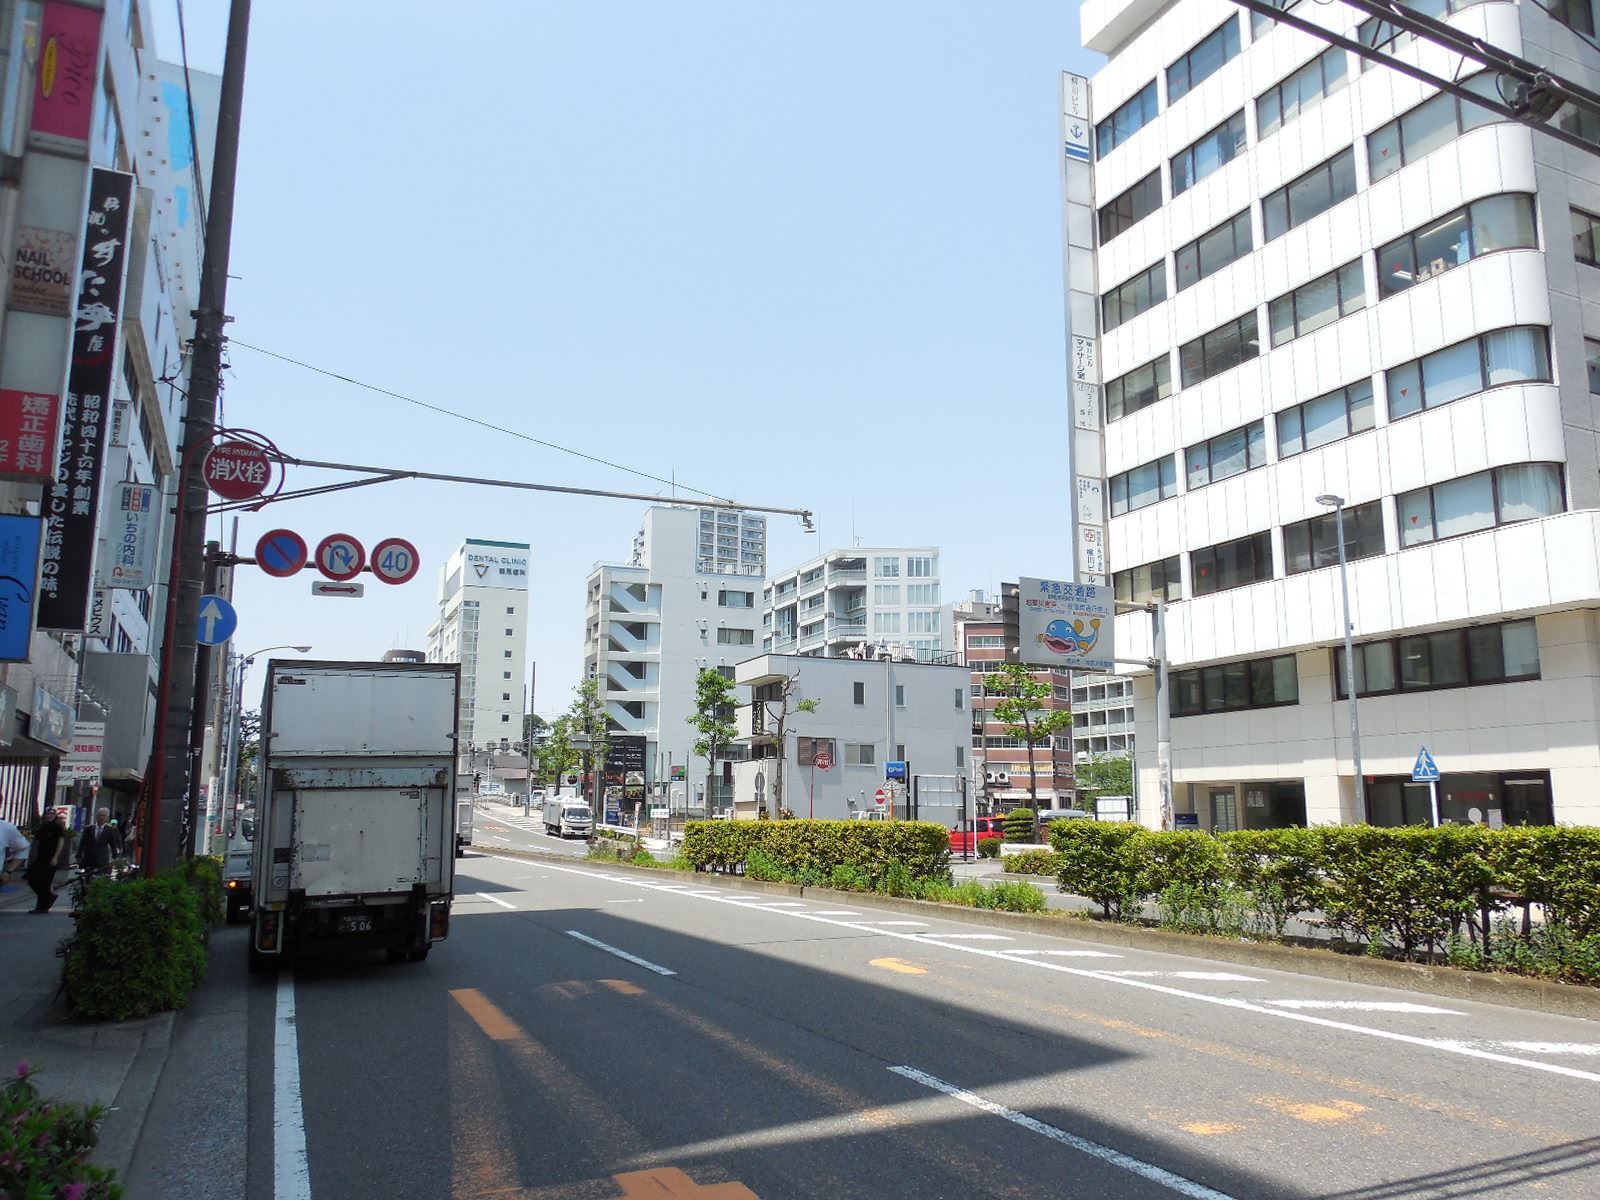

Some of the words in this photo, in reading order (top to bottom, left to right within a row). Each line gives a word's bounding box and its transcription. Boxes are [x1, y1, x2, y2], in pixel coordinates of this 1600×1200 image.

[16, 250, 50, 266] NAIL
[14, 265, 70, 285] SCHOOL
[16, 395, 50, 472] 矯正歯科
[210, 456, 266, 484] 消火栓
[381, 550, 408, 572] 40
[468, 554, 498, 563] DENTAL
[501, 557, 527, 566] CLINIC
[1040, 580, 1096, 598] 緊急交通路
